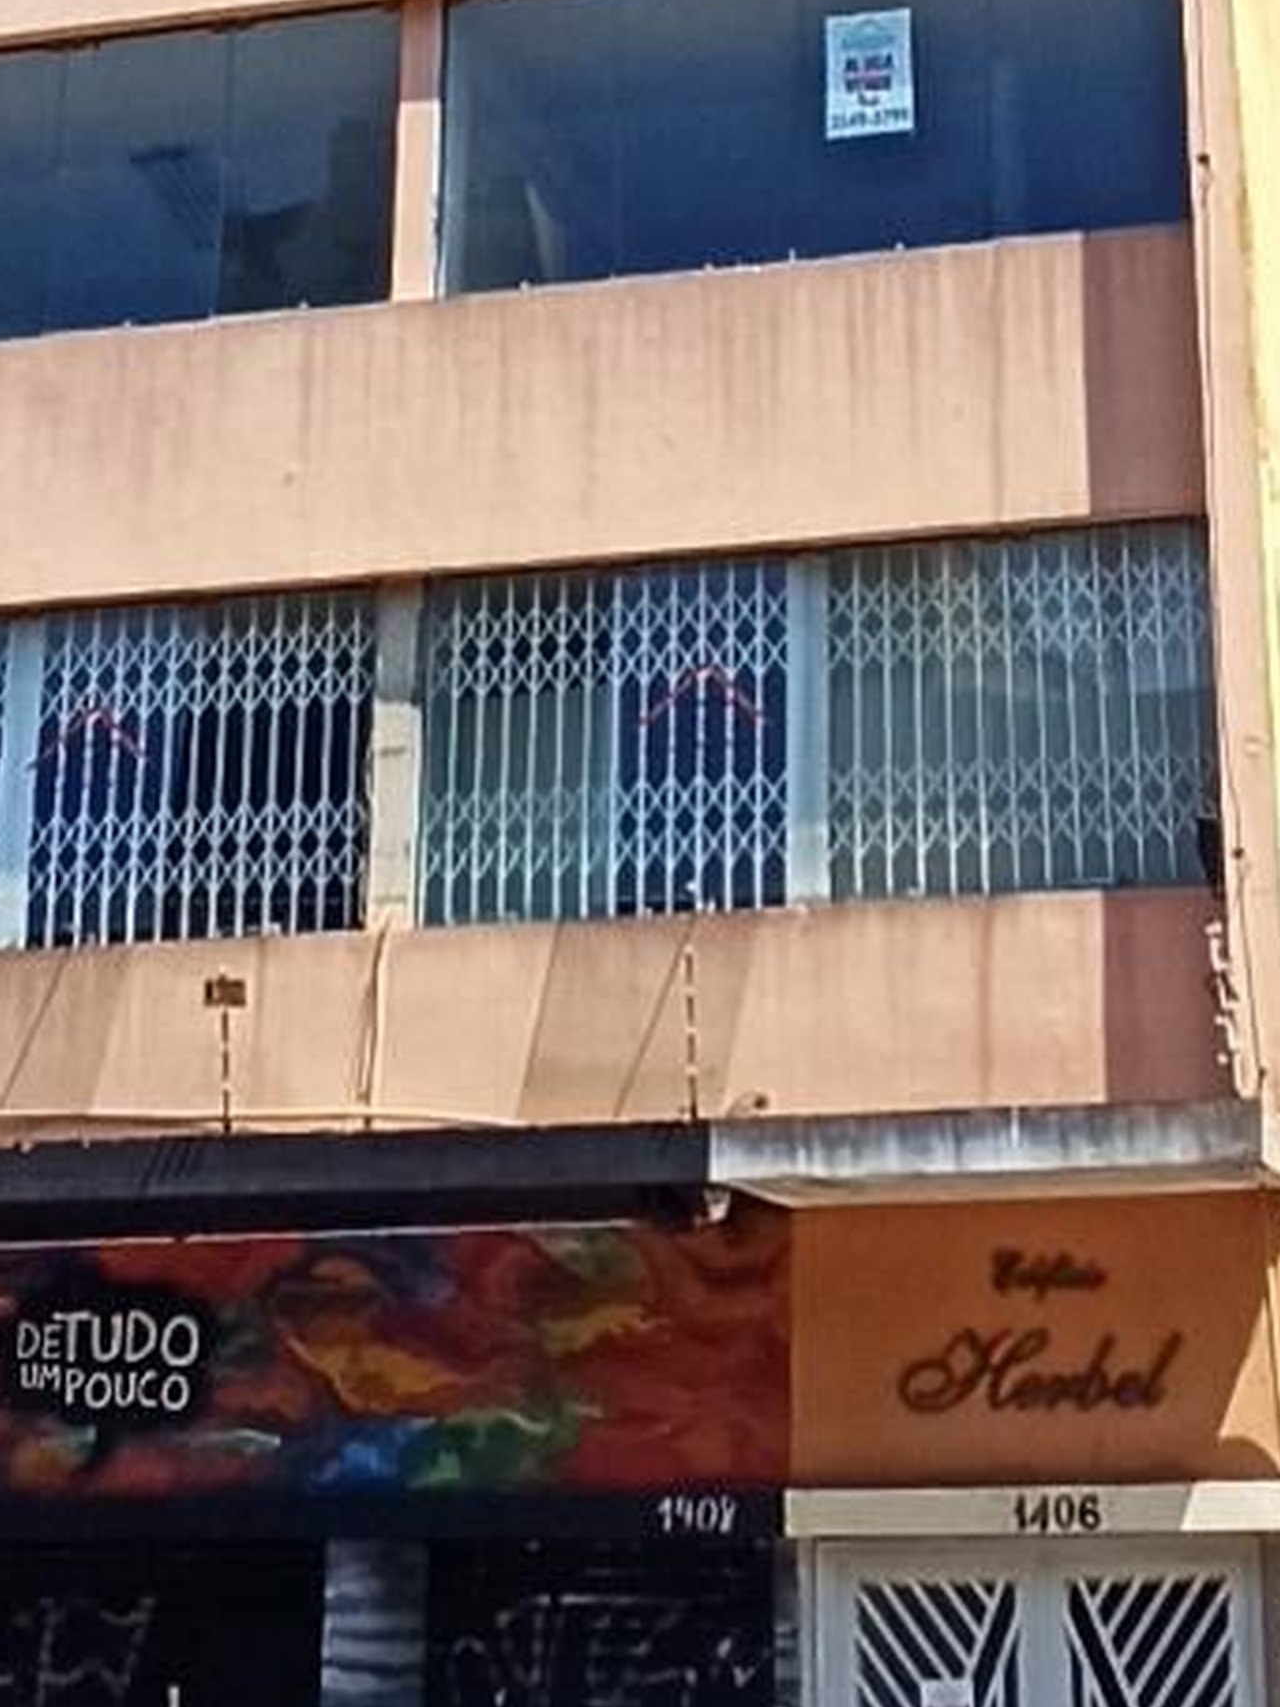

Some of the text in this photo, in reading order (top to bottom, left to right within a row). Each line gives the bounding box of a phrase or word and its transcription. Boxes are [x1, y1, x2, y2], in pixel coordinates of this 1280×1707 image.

[17, 1309, 200, 1368] DE TUDO
[20, 1362, 190, 1412] UM POUCO
[1014, 1492, 1102, 1532] 1406
